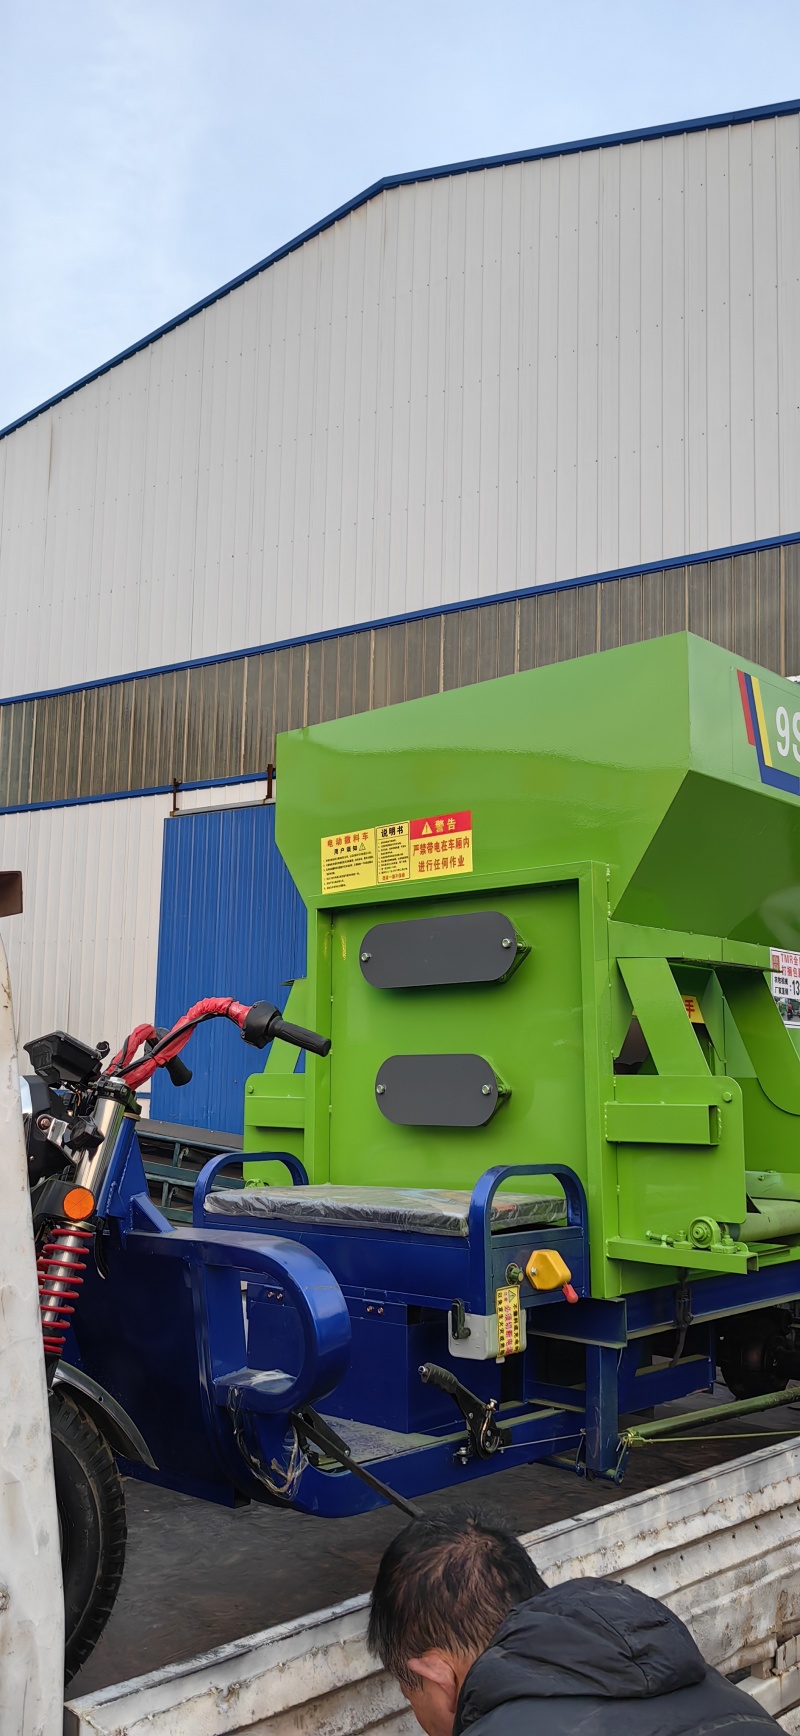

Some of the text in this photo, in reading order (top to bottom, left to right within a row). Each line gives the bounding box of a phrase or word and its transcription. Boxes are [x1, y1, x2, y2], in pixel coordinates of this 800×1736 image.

[381, 825, 404, 838] 说明书
[434, 817, 457, 833] 警告
[327, 831, 369, 848] 电动撒料车
[412, 836, 470, 856] 严禁带电在车厢内
[418, 854, 465, 873] 进行任何作业
[781, 953, 800, 966] TMR全
